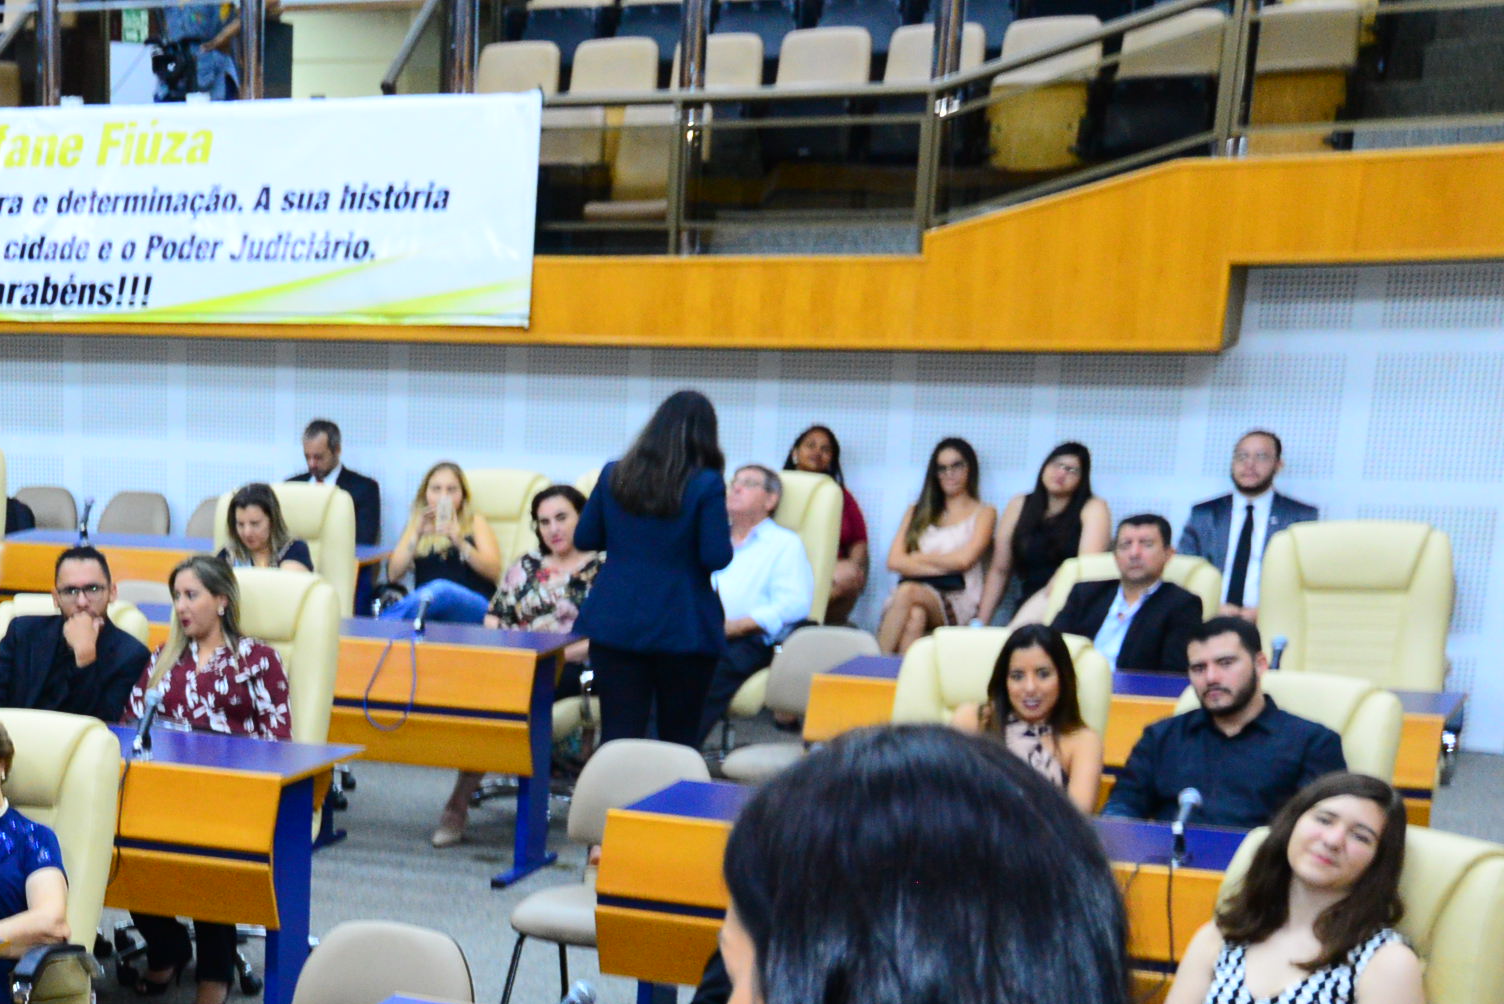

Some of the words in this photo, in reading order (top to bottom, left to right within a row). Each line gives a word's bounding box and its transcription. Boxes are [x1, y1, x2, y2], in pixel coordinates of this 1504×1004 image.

[96, 120, 213, 166] Fiúza
[33, 195, 48, 214] e
[57, 185, 243, 218] determinação.
[253, 186, 271, 211] A
[281, 192, 330, 211] sua
[339, 182, 450, 211] história
[4, 236, 90, 261] cidade
[97, 240, 112, 260] e
[121, 240, 136, 260] o
[145, 235, 223, 261] Poder
[230, 231, 376, 261] Judiciário.
